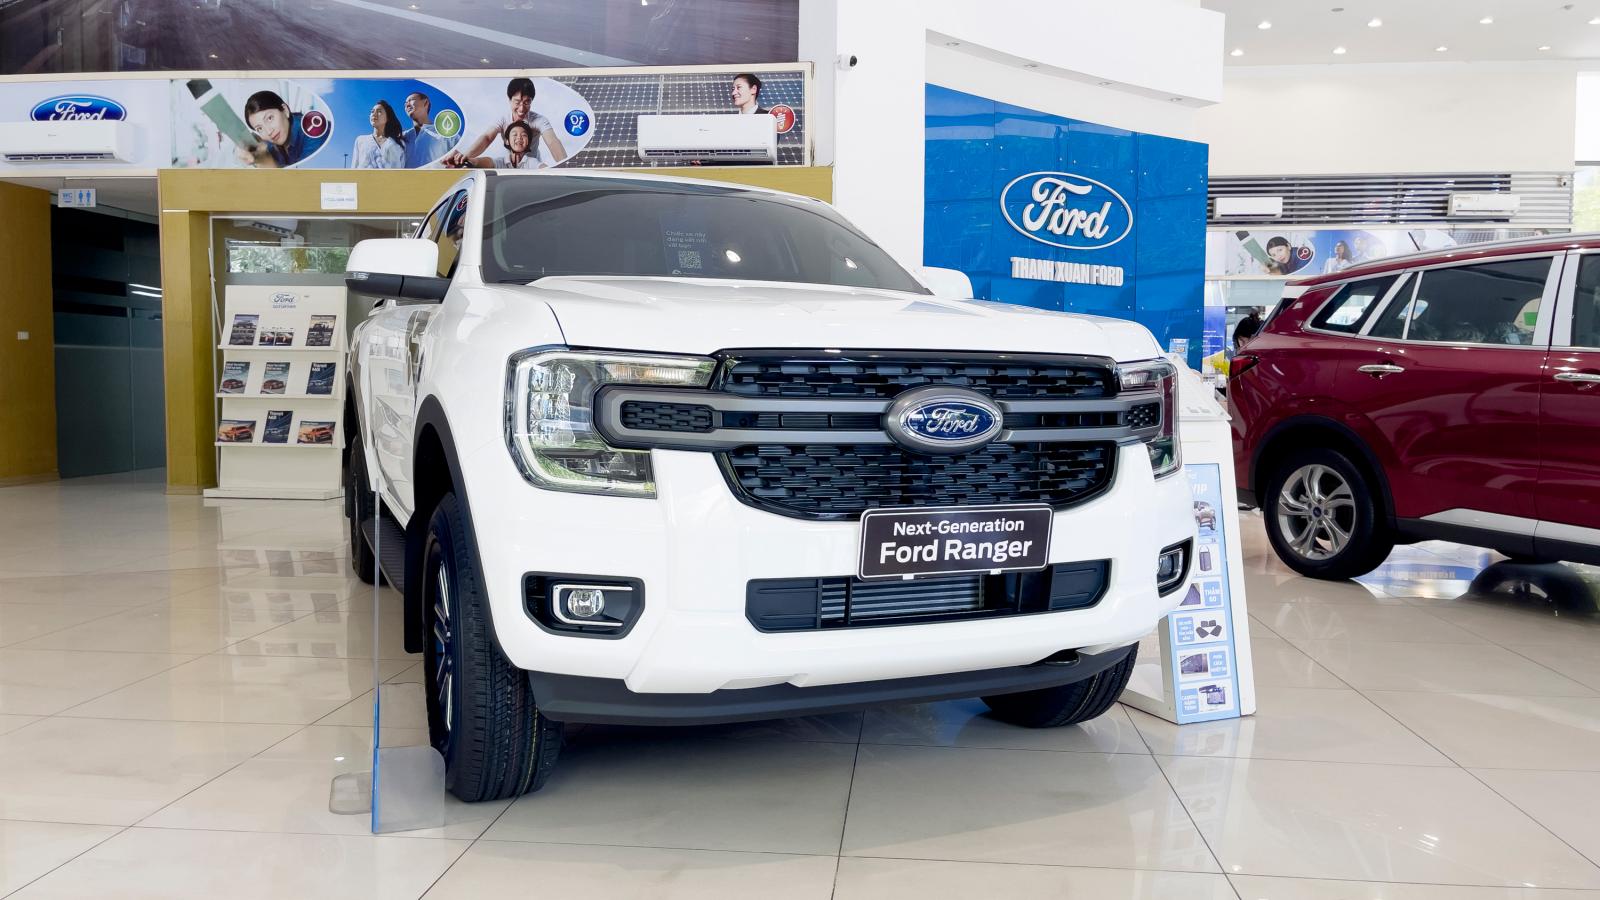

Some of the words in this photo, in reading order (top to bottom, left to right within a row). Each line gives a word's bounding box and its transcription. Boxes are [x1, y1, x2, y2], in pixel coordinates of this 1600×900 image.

[1023, 177, 1112, 239] Ford
[1010, 256, 1054, 280] THANH
[1054, 261, 1089, 284] XUAN
[1090, 264, 1124, 287] FORD
[272, 293, 295, 303] Ford
[926, 407, 980, 433] Ford
[893, 518, 1025, 536] Next-Generation
[879, 539, 939, 564] Ford
[944, 539, 1033, 562] Ranger
